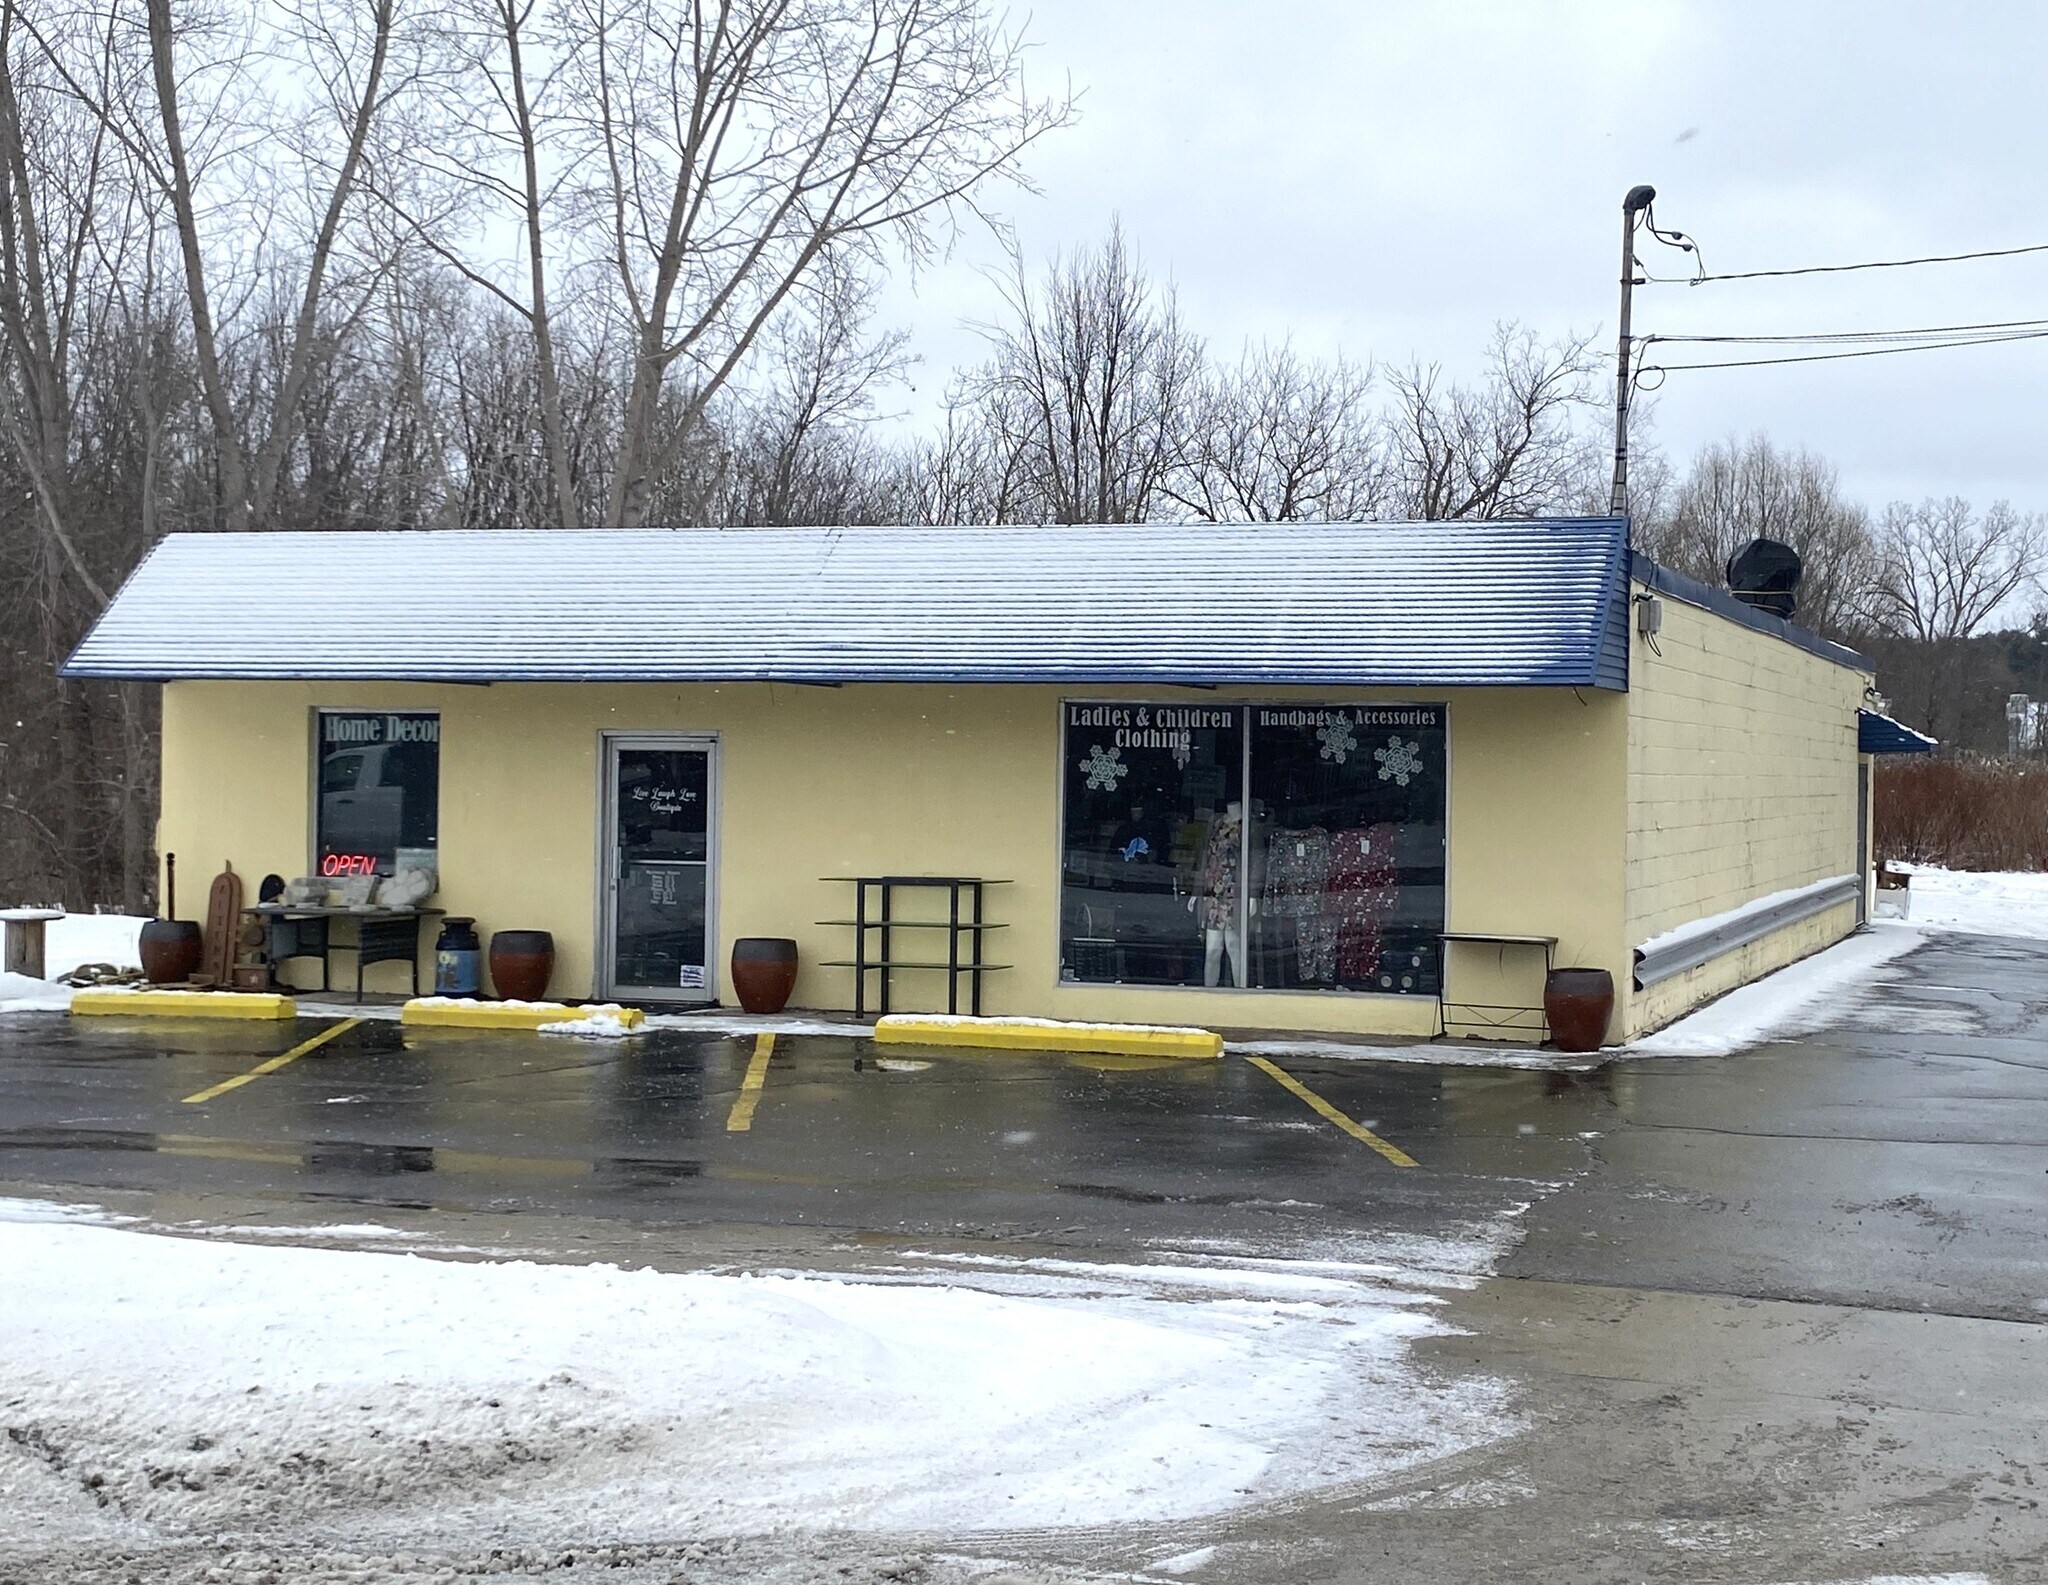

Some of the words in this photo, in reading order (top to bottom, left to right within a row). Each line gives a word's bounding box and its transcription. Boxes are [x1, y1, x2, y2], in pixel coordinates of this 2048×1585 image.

[325, 716, 381, 742] Home
[386, 715, 439, 742] Decor
[1070, 706, 1131, 727] Ladies
[1136, 706, 1150, 727] &
[1156, 708, 1232, 729] Children
[1260, 710, 1332, 727] Handbags
[1336, 710, 1348, 726] &
[1355, 709, 1436, 725] Accessories
[1115, 728, 1191, 751] Clothing
[632, 786, 649, 800] Live
[651, 787, 676, 801] Laugh
[678, 788, 697, 802] Love
[650, 800, 682, 814] Boutique
[323, 854, 376, 877] OPEN
